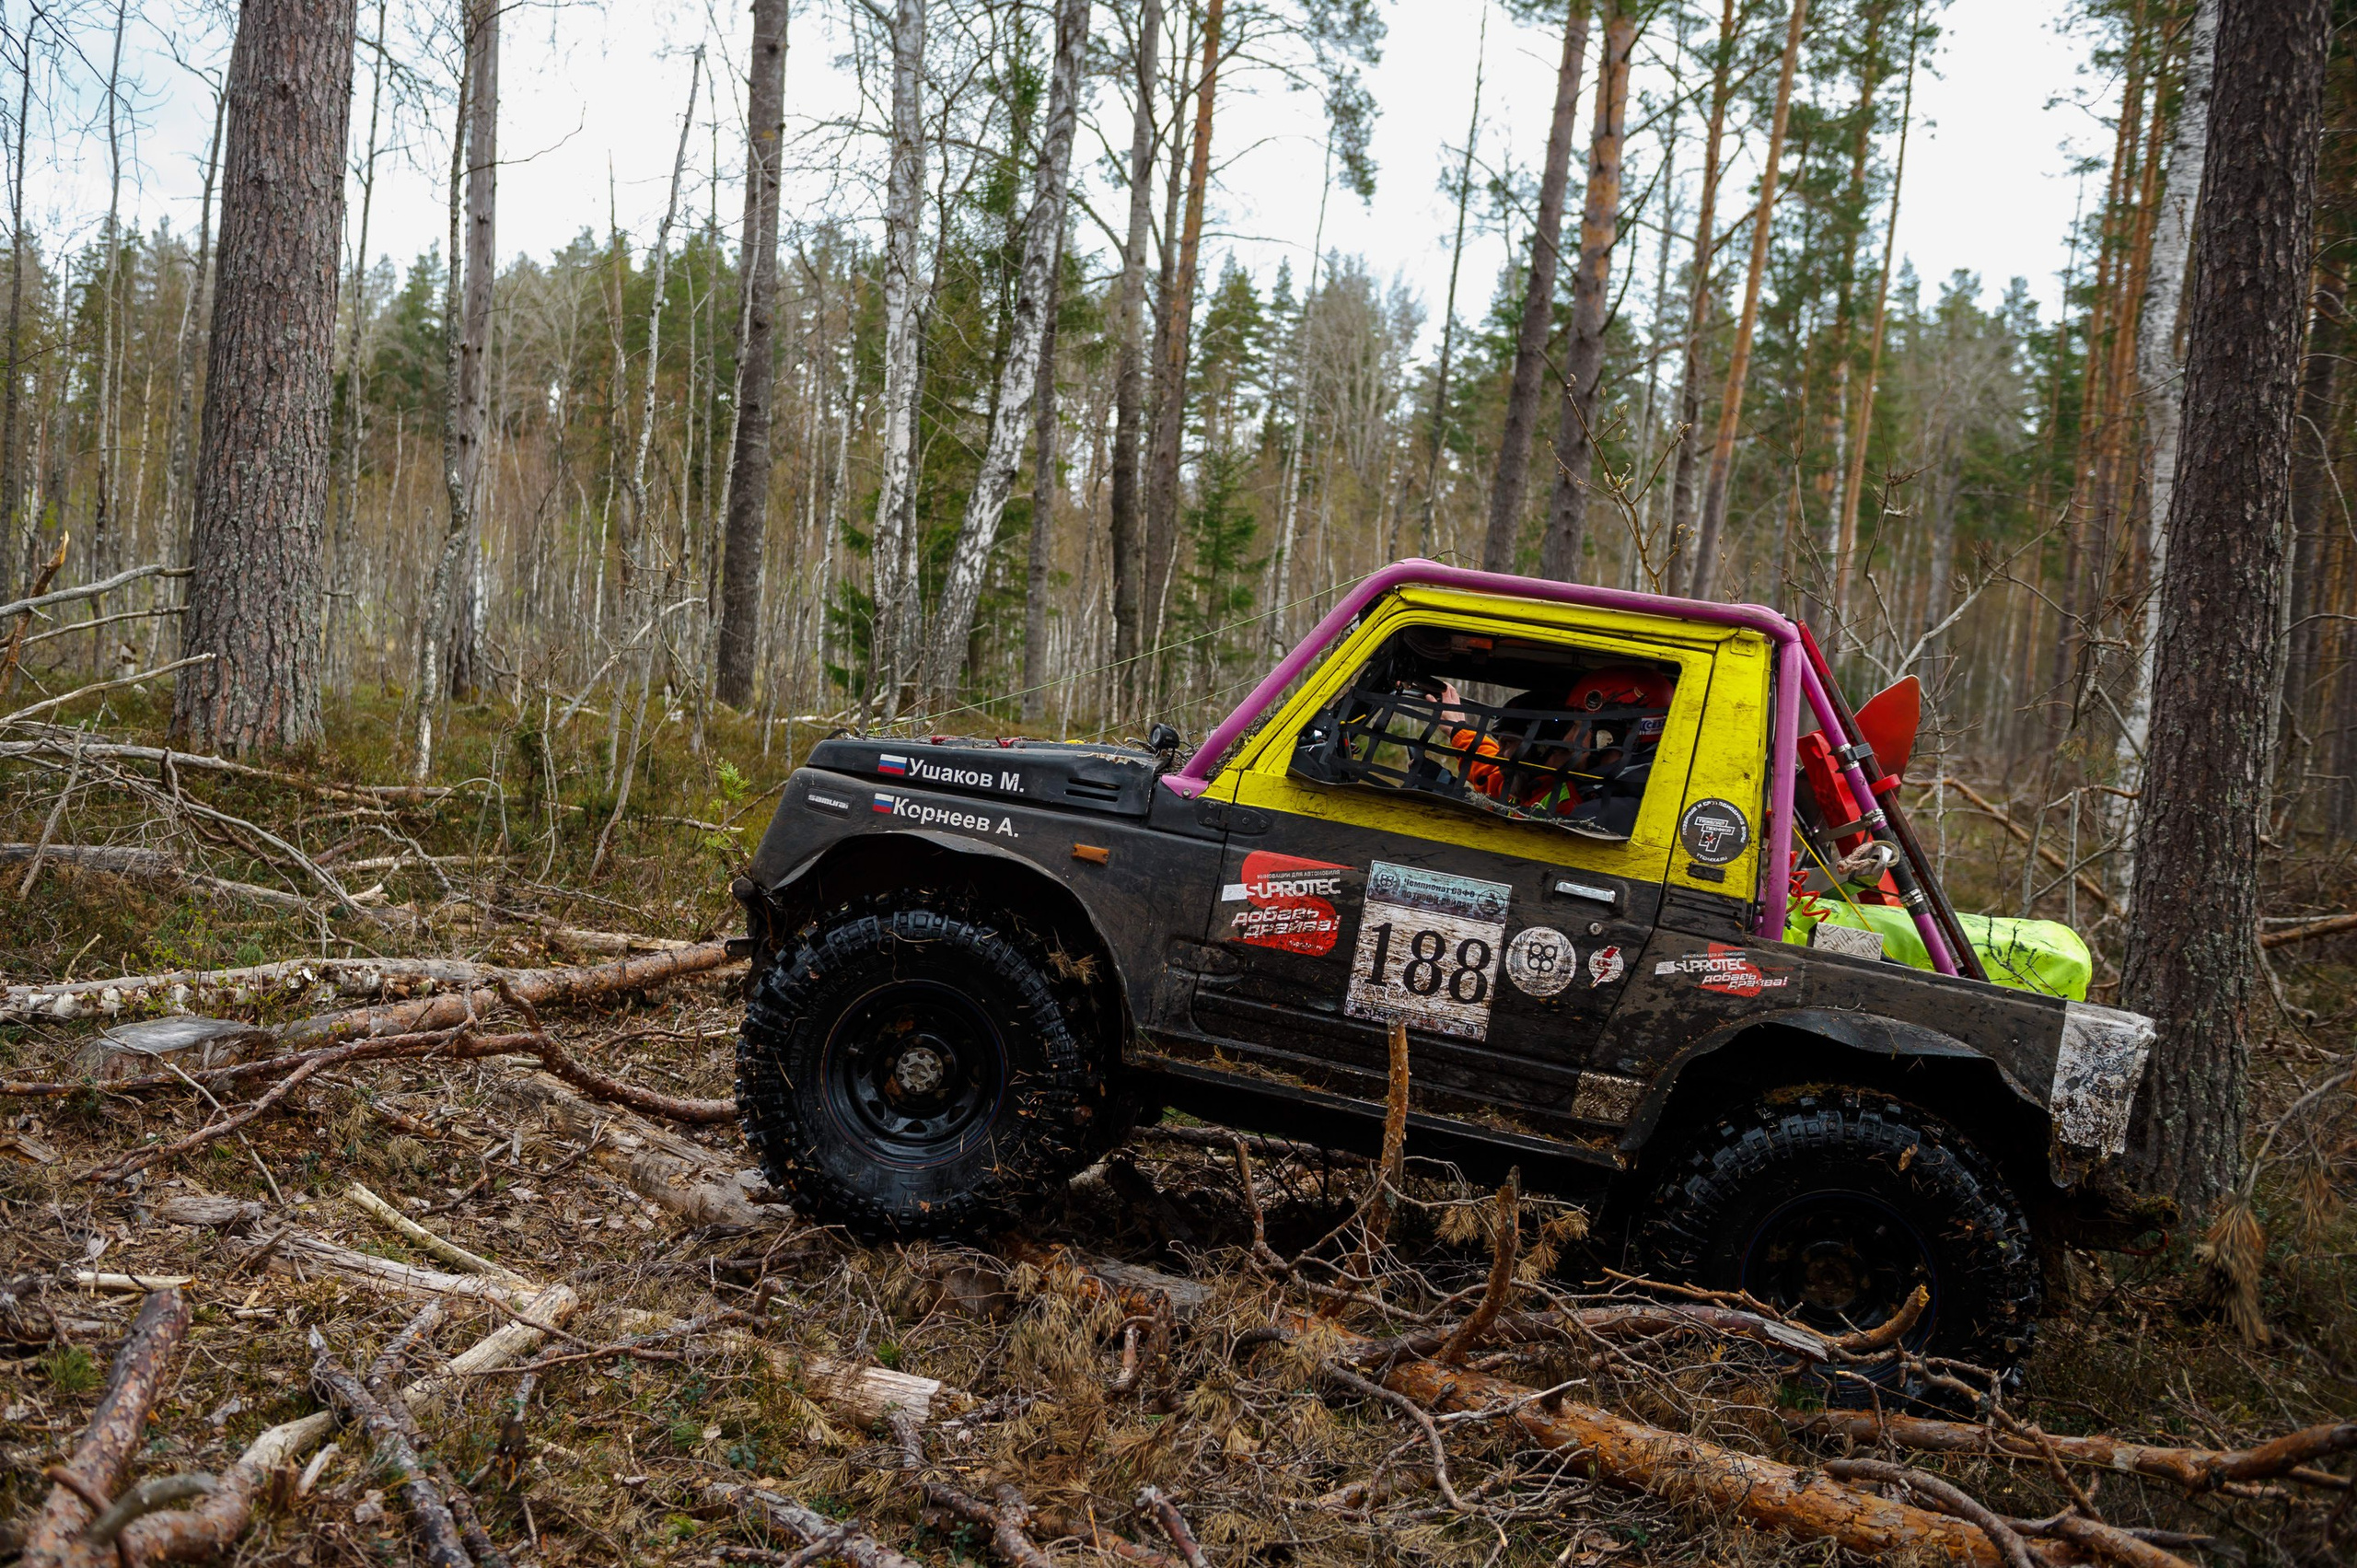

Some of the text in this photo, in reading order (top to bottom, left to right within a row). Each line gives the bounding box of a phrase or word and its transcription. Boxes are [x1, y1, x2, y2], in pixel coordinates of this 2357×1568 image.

[909, 758, 1025, 793] Ушаков М.
[807, 794, 849, 809] samurai
[893, 796, 1019, 838] Корнеев А.
[1245, 877, 1341, 899] SUPROTEC
[1404, 877, 1450, 893] Чемпионат
[1364, 922, 1492, 1005] 188
[1671, 958, 1747, 973] SUPROTEC
